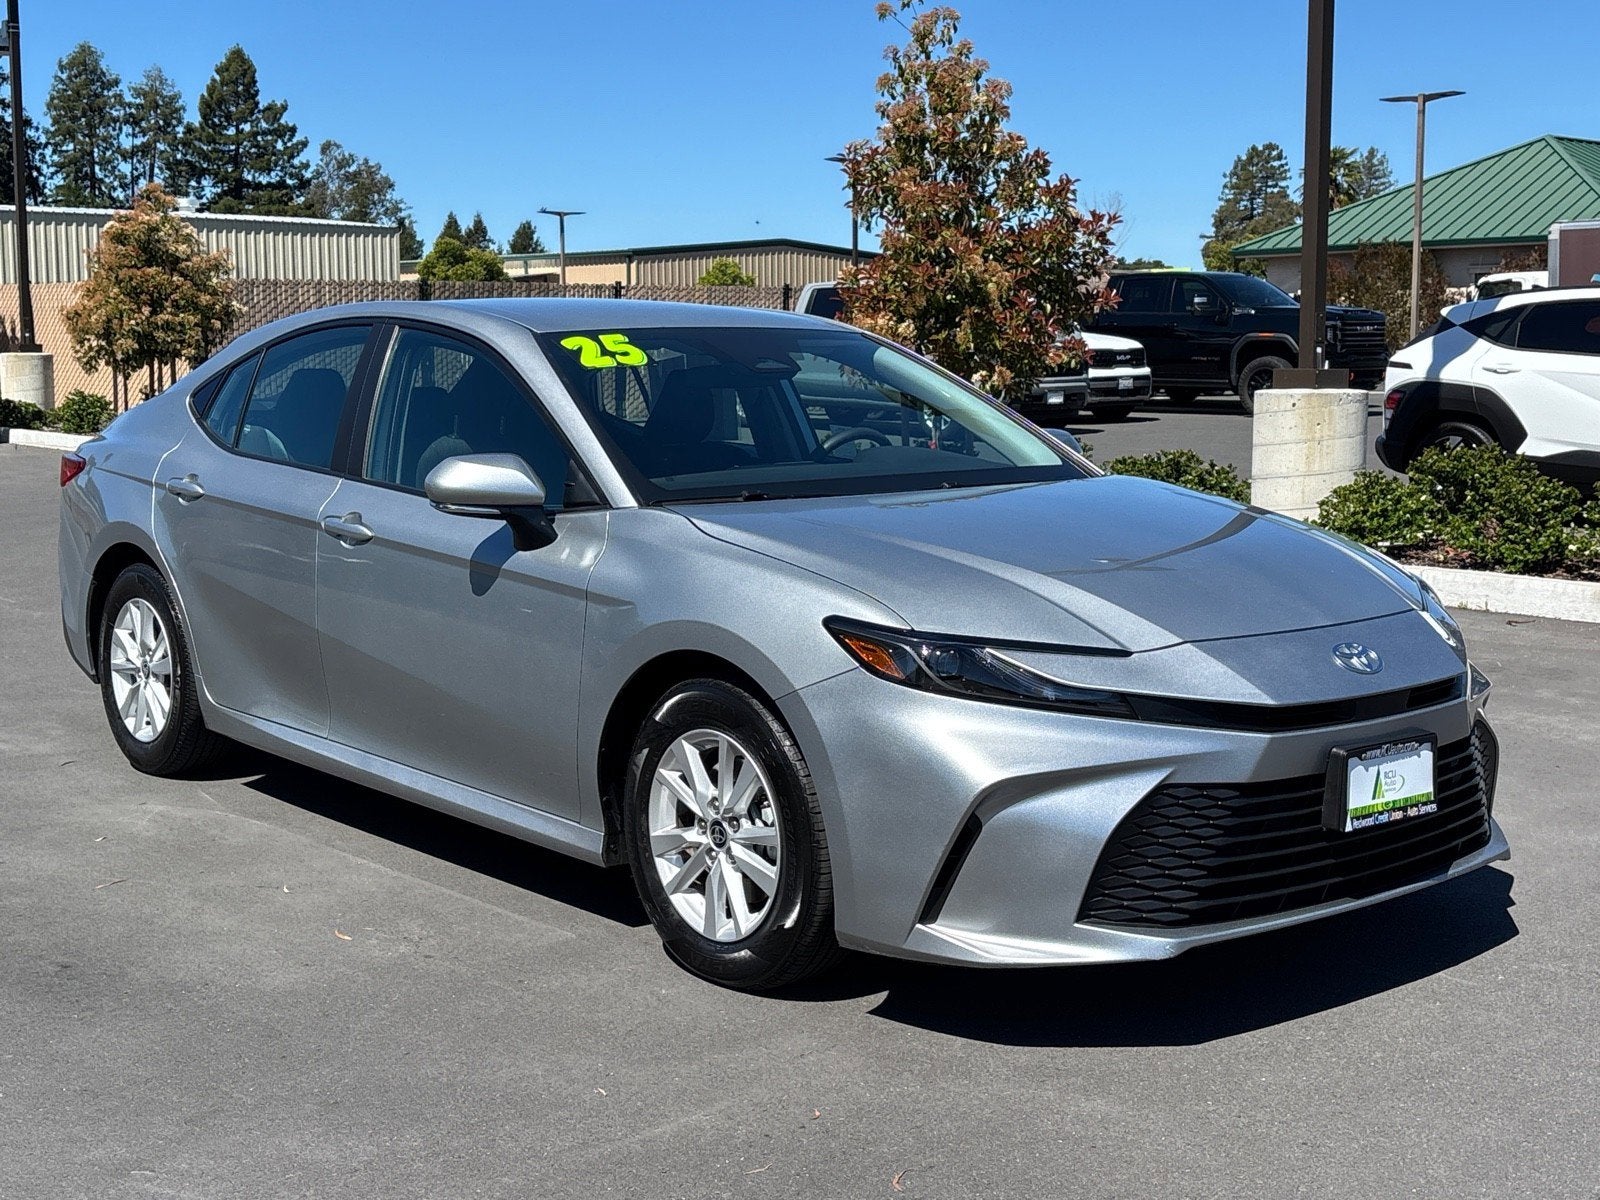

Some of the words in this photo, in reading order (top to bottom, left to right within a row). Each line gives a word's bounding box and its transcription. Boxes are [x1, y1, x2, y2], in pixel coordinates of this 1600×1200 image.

[560, 334, 648, 368] 25
[1384, 769, 1396, 780] RCU
[1353, 813, 1375, 828] Redwood
[1375, 812, 1389, 824] Credit
[1389, 810, 1404, 821] Union
[1407, 806, 1418, 817] Auto
[1419, 803, 1438, 815] Services
